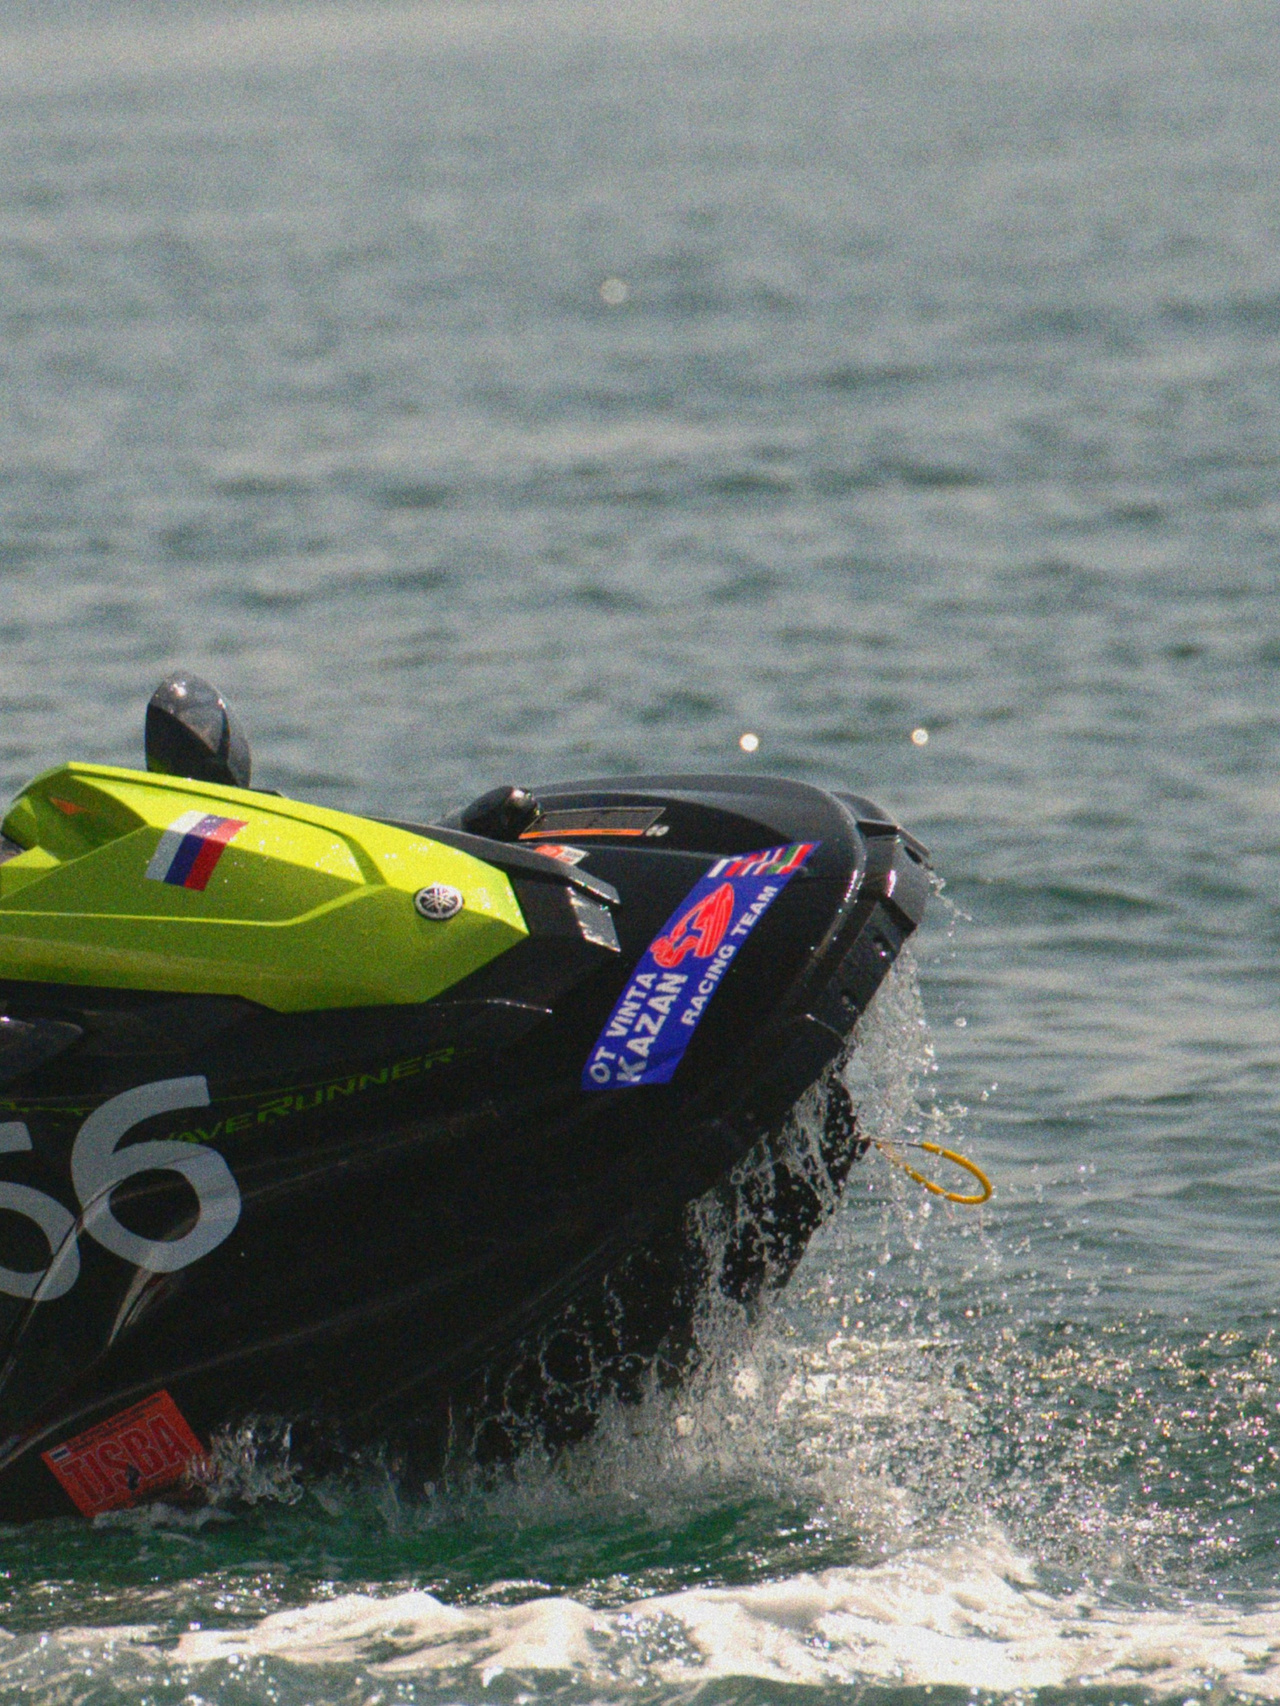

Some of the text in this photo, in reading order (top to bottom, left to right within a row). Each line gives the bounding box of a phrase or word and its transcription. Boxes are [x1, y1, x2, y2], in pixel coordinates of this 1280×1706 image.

[681, 886, 779, 1026] RACING TEAM
[589, 972, 658, 1084] OT VINTA
[616, 972, 688, 1083] KAZAN
[165, 1046, 455, 1145] AVERUNNER
